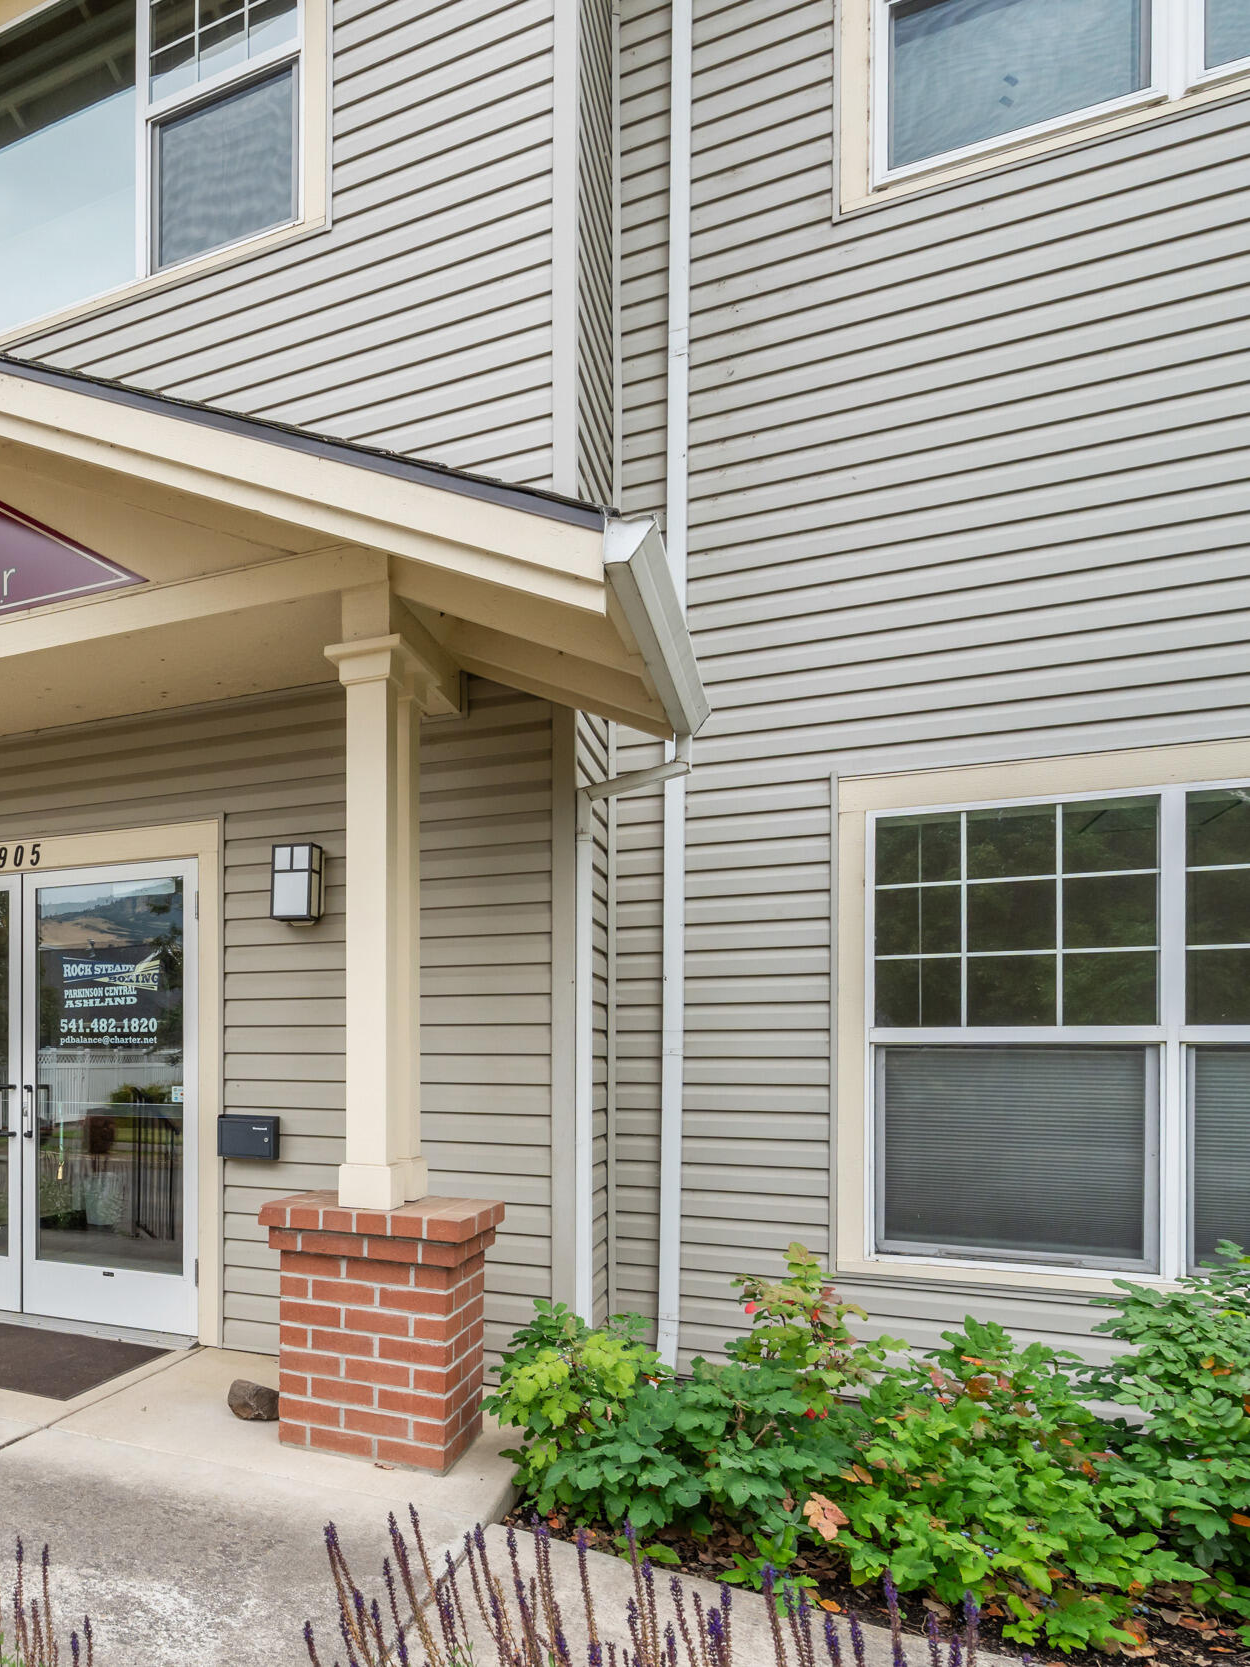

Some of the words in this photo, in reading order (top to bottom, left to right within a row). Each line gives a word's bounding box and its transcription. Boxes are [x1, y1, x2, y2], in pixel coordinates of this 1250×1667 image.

[62, 964, 92, 978] ROCK
[94, 964, 136, 975] STEADY
[64, 987, 104, 999] PARKINSON
[104, 986, 137, 996] CENTRAL
[64, 996, 138, 1009] ASHLAND
[59, 1018, 158, 1033] 541.482.1820
[60, 1035, 158, 1046] pdbalance@charter.net
